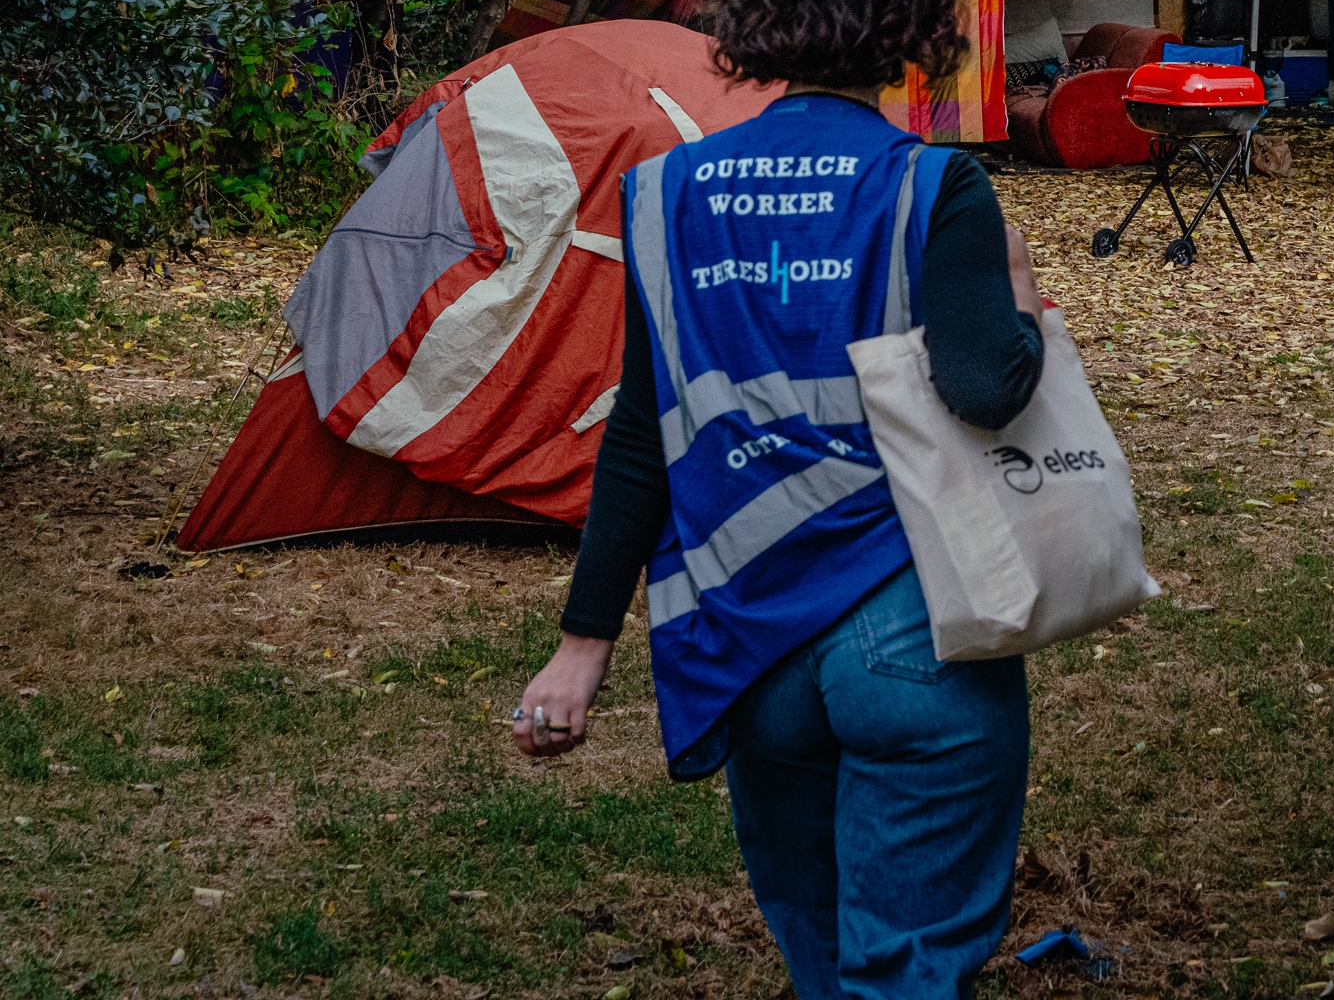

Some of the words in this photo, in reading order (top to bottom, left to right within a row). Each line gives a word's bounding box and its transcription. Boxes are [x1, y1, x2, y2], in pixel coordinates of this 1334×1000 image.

[694, 155, 860, 182] OUTREACH
[707, 191, 835, 216] WORKER
[1043, 447, 1106, 474] eleos
